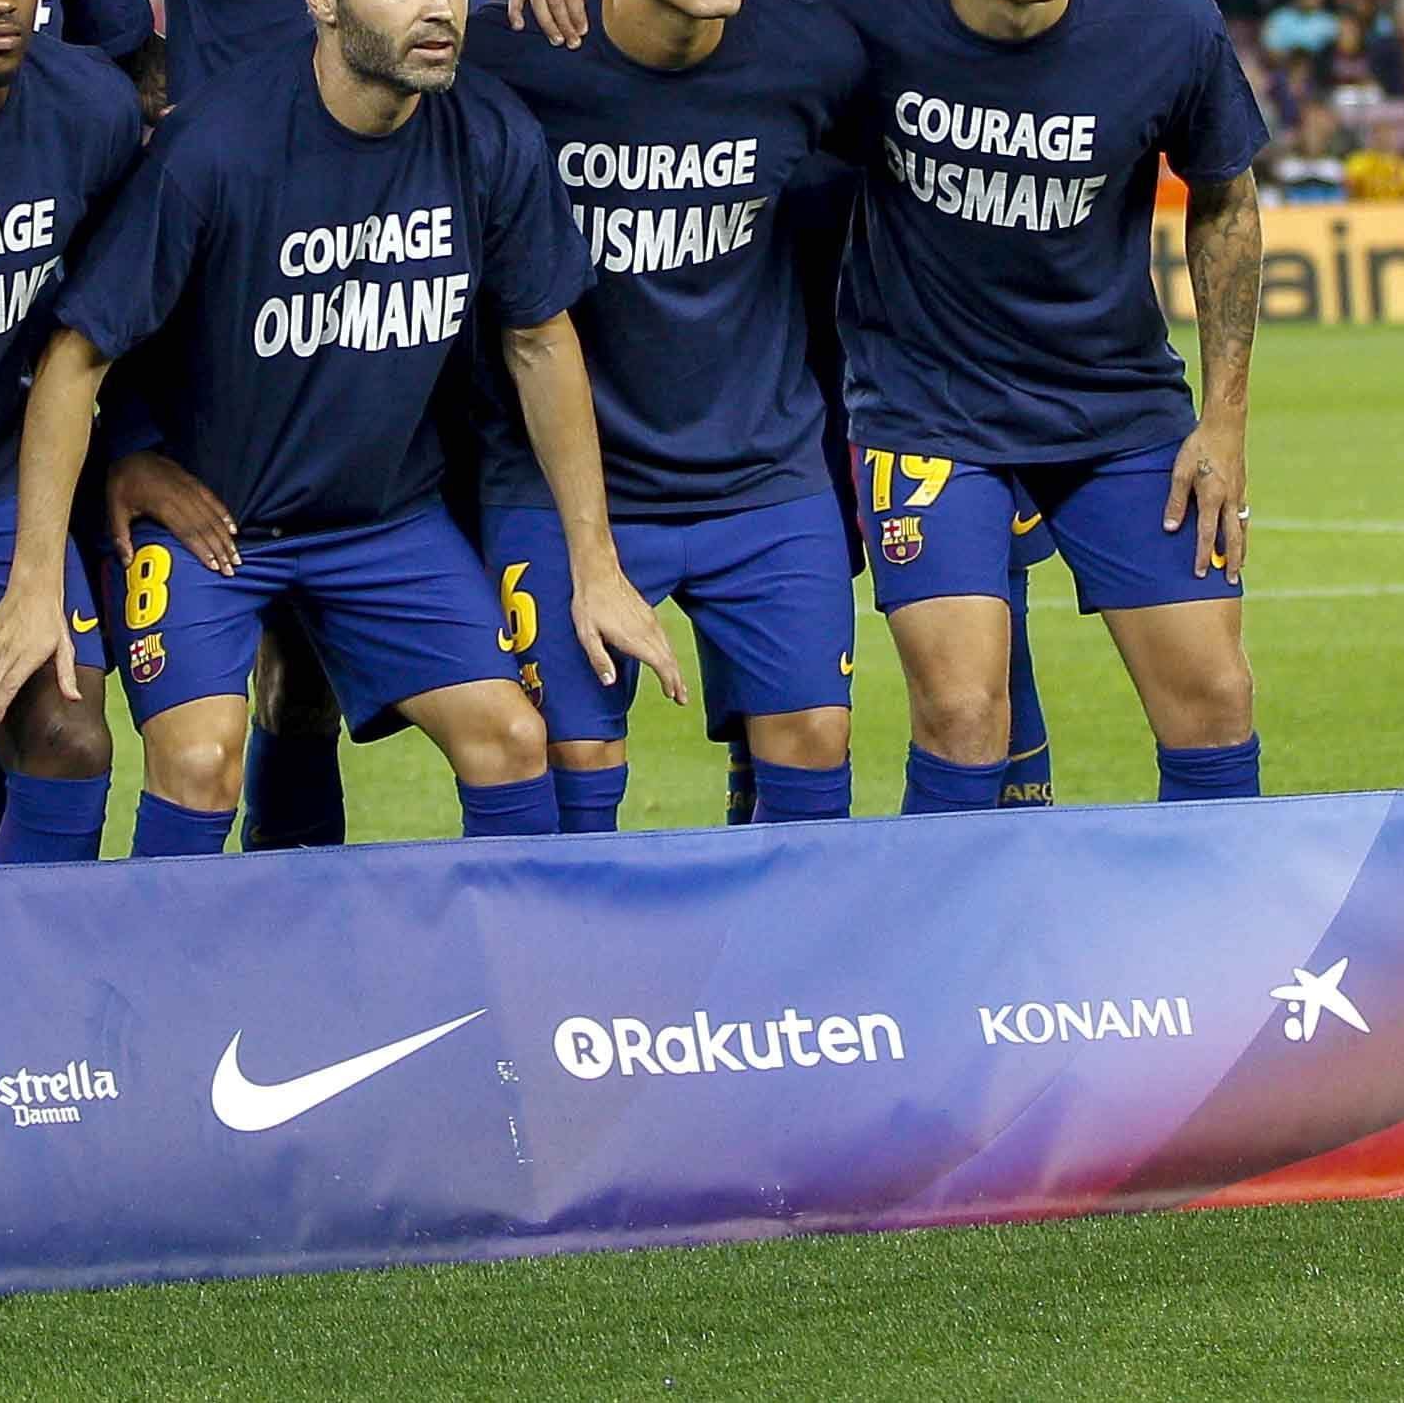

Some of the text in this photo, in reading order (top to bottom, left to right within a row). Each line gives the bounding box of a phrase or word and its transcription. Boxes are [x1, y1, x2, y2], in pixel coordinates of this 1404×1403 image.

[895, 91, 1096, 161] COURAGE
[558, 138, 757, 190] COURAGE
[279, 206, 453, 277] COURAGE
[572, 196, 768, 274] USMANE
[254, 273, 470, 358] OUSMANE
[864, 448, 953, 513] 19
[125, 543, 172, 630] 8
[500, 562, 538, 653] 6
[613, 1009, 905, 1076] Rakuten
[978, 997, 1193, 1046] KONAMI
[11, 1104, 81, 1128] Damm
